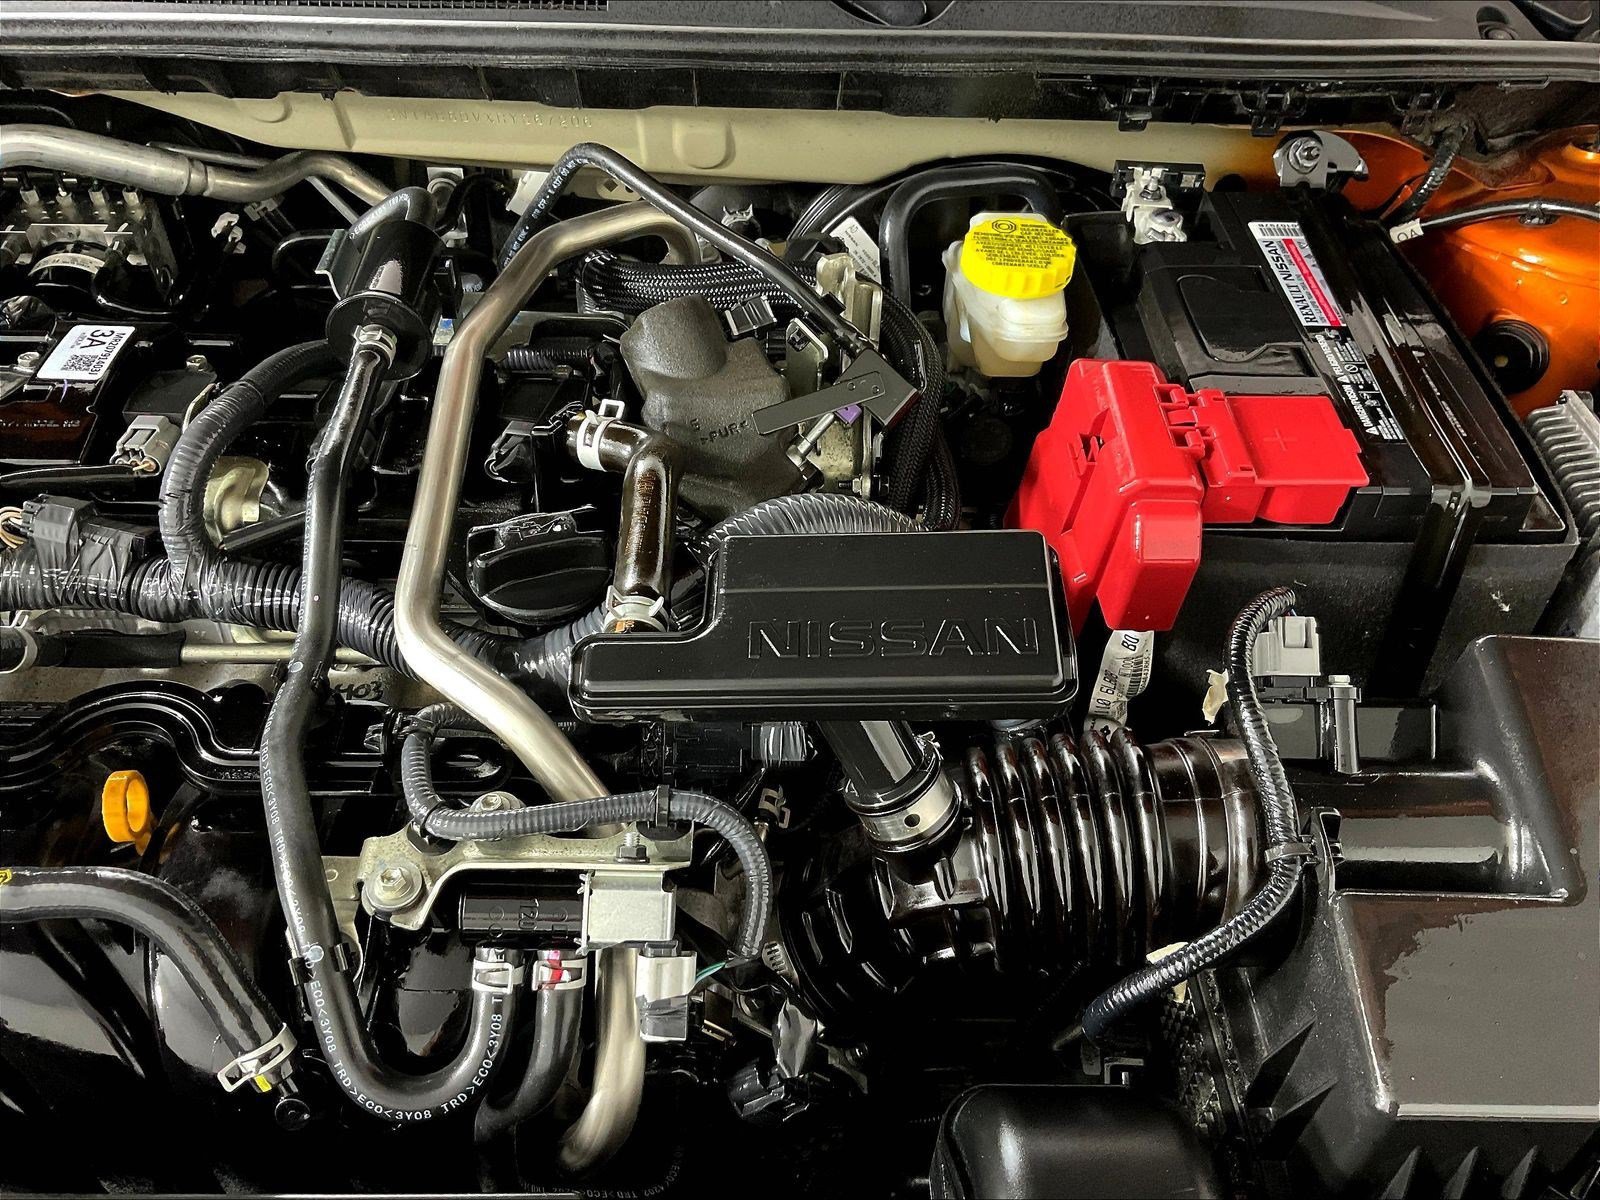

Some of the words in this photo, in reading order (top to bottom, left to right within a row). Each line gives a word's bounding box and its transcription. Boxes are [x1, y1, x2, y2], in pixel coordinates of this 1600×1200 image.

[1263, 240, 1295, 281] NISSAN
[1286, 284, 1319, 324] RENAULT
[80, 329, 115, 349] 3A
[748, 617, 1040, 659] NISSAN
[333, 1060, 432, 1121] TRD>ECO<3Y08
[441, 1013, 503, 1114] TRD>ECO<3Y08
